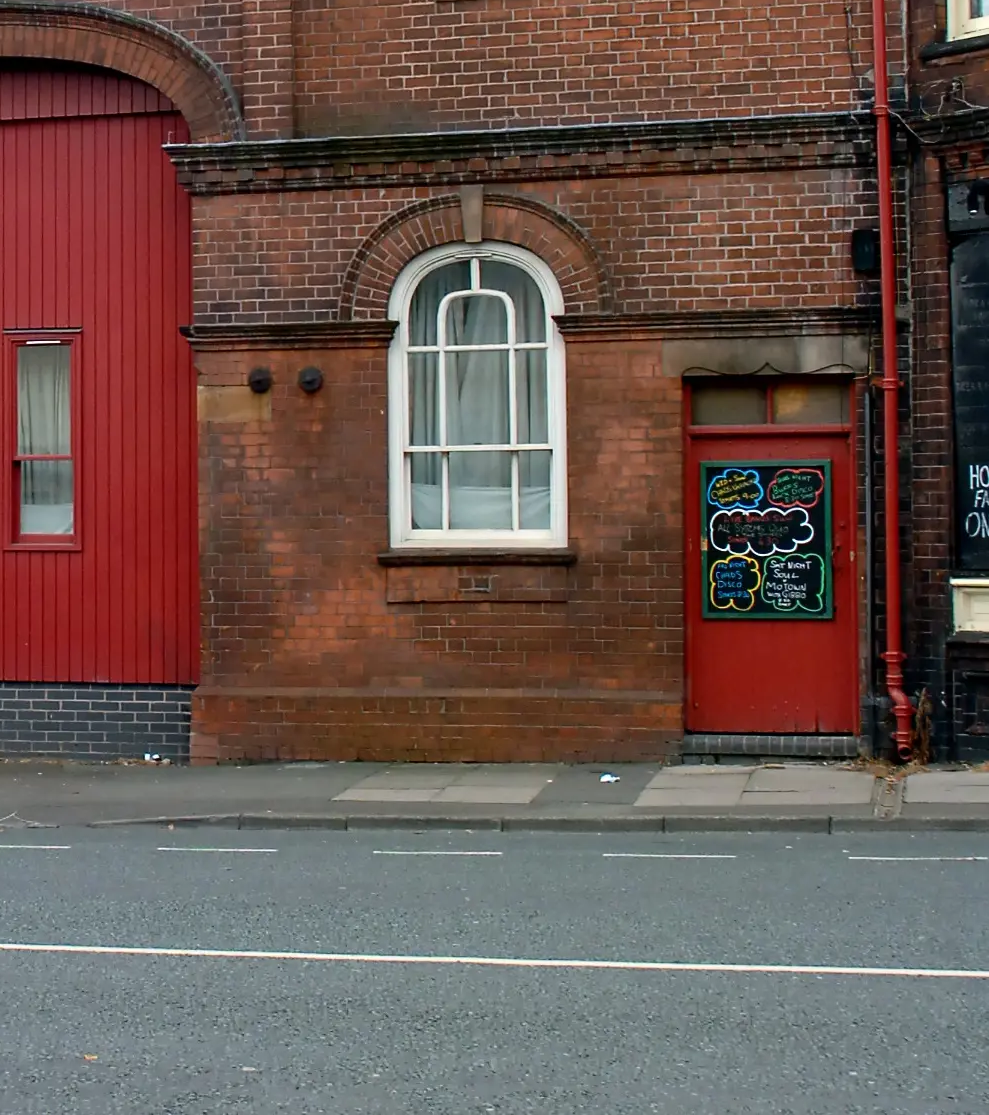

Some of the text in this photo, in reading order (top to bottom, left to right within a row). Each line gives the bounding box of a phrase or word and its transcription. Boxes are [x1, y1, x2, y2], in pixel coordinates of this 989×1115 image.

[769, 560, 812, 570] SAT NIGHT
[773, 568, 800, 579] SOUL
[717, 580, 742, 588] DISCO
[765, 581, 807, 591] MOTOWN
